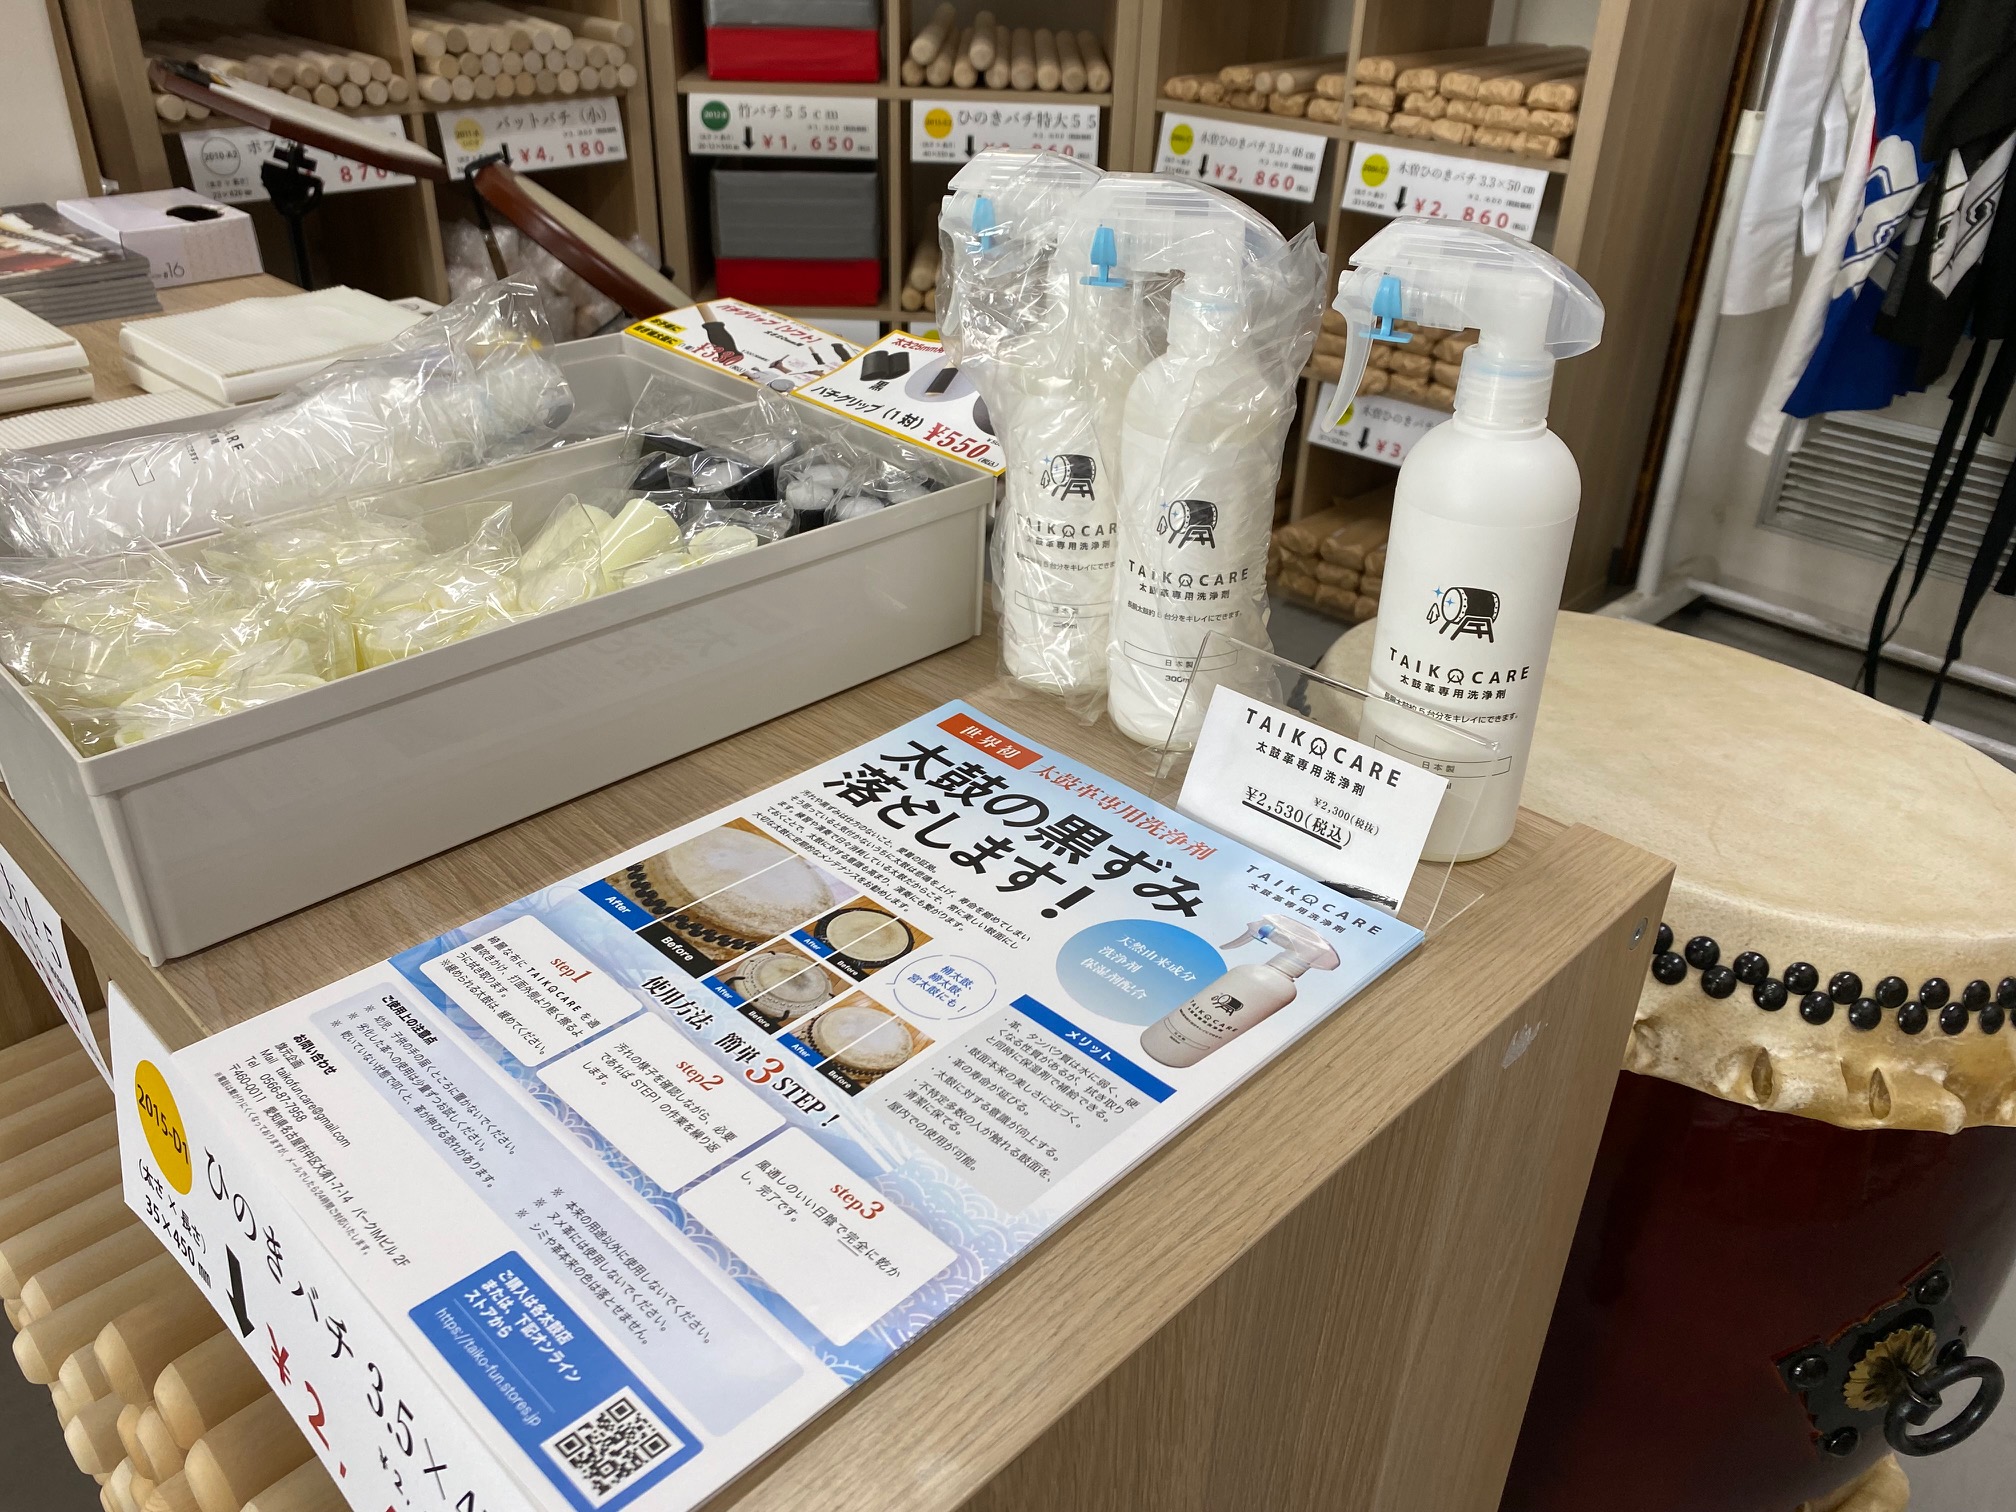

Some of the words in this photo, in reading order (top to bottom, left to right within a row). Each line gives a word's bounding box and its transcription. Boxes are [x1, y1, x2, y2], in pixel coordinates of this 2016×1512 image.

[1214, 164, 1295, 191] ¥2,860
[1414, 198, 1509, 228] ¥2,860
[869, 380, 890, 392] 黒
[923, 422, 991, 459] ¥550
[1128, 559, 1249, 588] TAIKOCARE
[1139, 583, 1230, 601] 太鼓革専用洗浄剤
[1389, 647, 1530, 685] TAIKOCARE
[1400, 674, 1507, 700] 太鼓革専用洗浄剤
[1247, 708, 1401, 788] TAIKOCARE
[1256, 741, 1366, 796] 太鼓革専用洗浄剤
[1422, 761, 1455, 773] 日本製
[956, 724, 1025, 759] 世界初
[1029, 763, 1219, 861] 太鼓革専用洗浄剤
[1246, 786, 1352, 847] ¥2,530(税込)
[1313, 797, 1380, 837] ¥2,300(税抜)
[798, 789, 941, 874] 汚れや黒ずみは仕方のないこと、愛着の証拠。
[817, 761, 1099, 920] 落とします!
[874, 735, 1227, 925] 太鼓の黒ずみ
[603, 895, 633, 914] After
[657, 936, 697, 961] Before
[1243, 864, 1383, 936] TAIKOCARE
[1246, 882, 1346, 934] 太鼓革専用洗浄剤
[453, 951, 512, 998] うに拭き取ります。
[484, 935, 530, 968] 綺麗な布に
[524, 966, 583, 1012] TAIKOCARE
[576, 1012, 603, 1029] を適
[546, 956, 593, 984] step1
[801, 938, 823, 951] After
[835, 960, 860, 976] Before
[1077, 956, 1152, 1000] 保湿剤配合
[1096, 945, 1143, 973] 洗浄剤
[1115, 934, 1200, 982] 天然由来成分
[436, 958, 553, 1055] ※緩められる太鼓は、緩めてください。
[467, 943, 587, 1038] 量吹きかけ、打面外側より軽く擦るよ
[638, 974, 719, 1031] 使用方法
[712, 985, 735, 999] After
[746, 1010, 773, 1027] Before
[379, 994, 439, 1046] ご使用上の注意点
[1064, 1029, 1116, 1062] メリット
[272, 1041, 305, 1069] 旗元企画
[291, 1033, 339, 1076] お問い合わせ
[580, 1061, 613, 1086] します。
[671, 1059, 726, 1093] step2
[788, 1043, 812, 1058] After
[825, 1070, 854, 1089] Before
[983, 1035, 1113, 1122] と同時に保湿剤で補給できる。
[995, 1028, 1127, 1115] くなる性質があるが、拭き取り
[242, 1056, 261, 1069] Tel
[257, 1072, 309, 1123] 0566-87-7958
[257, 1048, 280, 1064] Mail
[274, 1066, 353, 1148] taikofun.care@gmail.com
[337, 1029, 500, 1189] 乾いていない状態で叩くと、革が伸びる恐れがあります。
[354, 1022, 492, 1152] 劣化した革への使用は少量ずつお試しください。
[371, 1014, 522, 1155] 幼児、子供の手の届くところに置かないでください。
[597, 1052, 635, 1080] であれば
[629, 1079, 662, 1104] STEP1
[656, 1102, 721, 1154] の作業を繰り返
[612, 1042, 739, 1143] 汚れの様子を確認しながら、必要
[901, 1088, 966, 1135] 清潔に保てる。
[138, 1083, 189, 1165] 2015-D1
[226, 1063, 268, 1103] 〒460-0011
[261, 1104, 356, 1205] 愛知県名古屋市中区大須1-7-14
[390, 1254, 411, 1269] 2F
[738, 1170, 803, 1223] し、完了です。
[753, 1159, 904, 1280] 風通しのいい日陰で完全に乾か
[827, 1183, 888, 1222] step3
[527, 1222, 655, 1346] シミや革本来の色は落とせません。
[544, 1211, 674, 1333] ヌメ革には使用しないでください。
[561, 1200, 718, 1344] 本来の用途以外に使用しないでください。
[461, 1288, 516, 1340] ストアから
[478, 1278, 585, 1385] または、下記オンライン
[495, 1269, 576, 1346] ご購入は各太鼓店
[430, 1307, 547, 1429] https://taiko-fun.stores.jp
